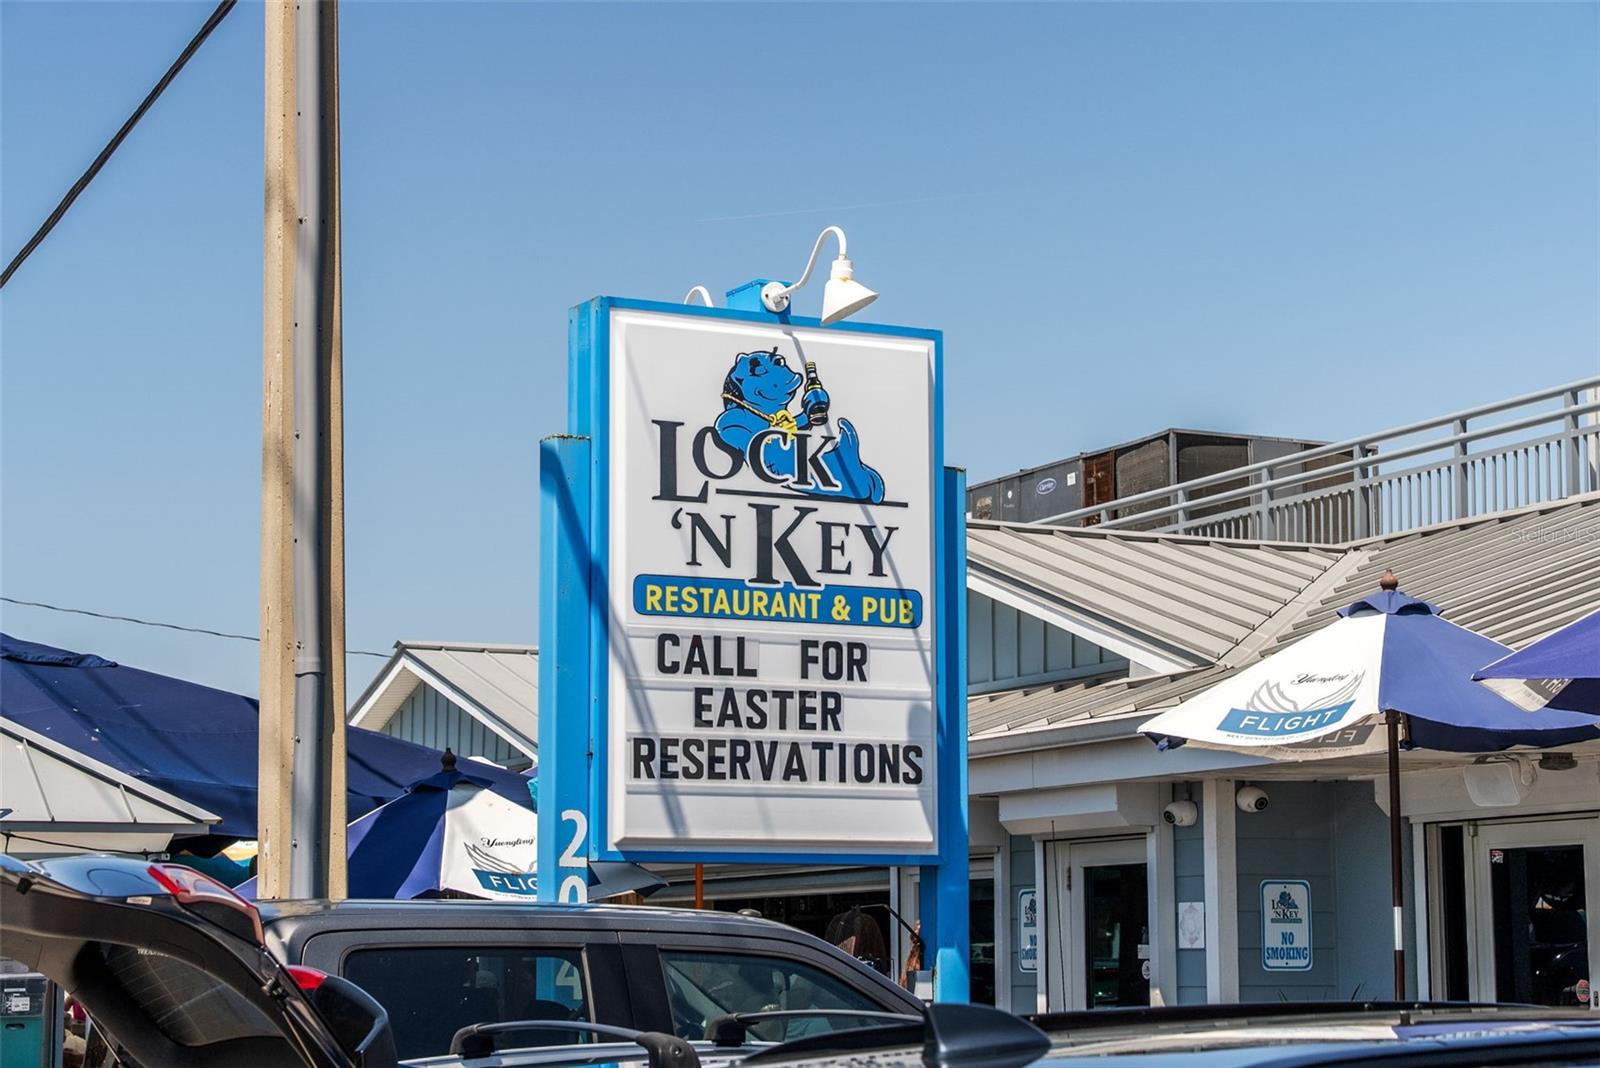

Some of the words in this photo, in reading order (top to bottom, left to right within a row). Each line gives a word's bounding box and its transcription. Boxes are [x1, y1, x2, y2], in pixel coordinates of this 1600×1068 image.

[651, 419, 840, 504] LOCK
[747, 502, 899, 587] KEY
[645, 584, 822, 620] RESTAURANT
[831, 595, 850, 621] &
[862, 597, 914, 625] PUB
[656, 633, 757, 677] CALL
[800, 639, 867, 682] FOR
[694, 687, 842, 731] EASTER
[1239, 709, 1338, 732] FLIGHT
[632, 737, 923, 785] RESERVATIONS
[481, 837, 536, 848] Yuengling
[489, 875, 538, 890] FLIG
[1265, 946, 1309, 961] SMOKING
[1281, 931, 1295, 946] NO
